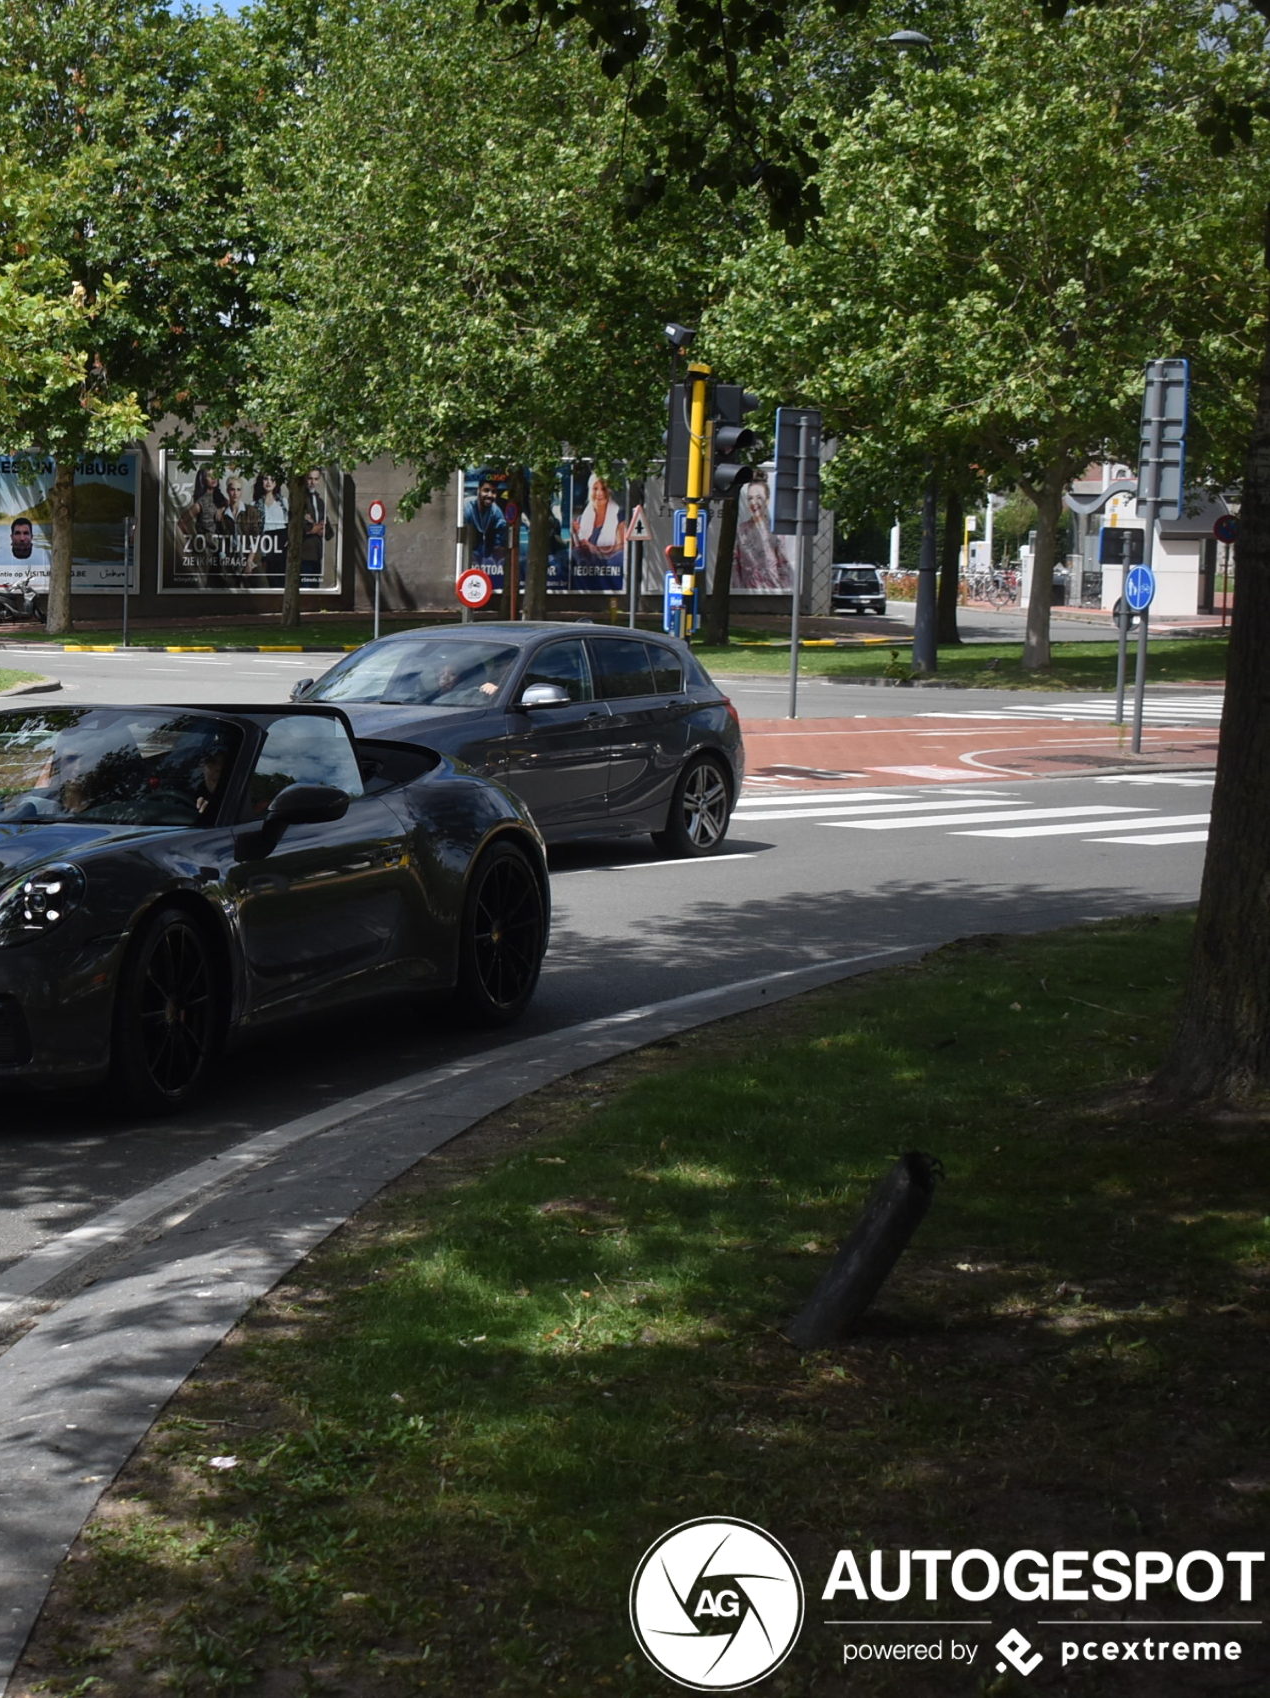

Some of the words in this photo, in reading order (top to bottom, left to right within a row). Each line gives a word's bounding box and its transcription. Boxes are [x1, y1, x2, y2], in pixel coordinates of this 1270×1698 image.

[74, 462, 129, 476] MBURG
[183, 534, 207, 553] ZO
[208, 534, 282, 554] STIJLVOL
[183, 556, 195, 567] ZIE
[207, 556, 218, 567] ME
[219, 556, 247, 567] GRAAG
[573, 565, 621, 577] IEDEREEN!
